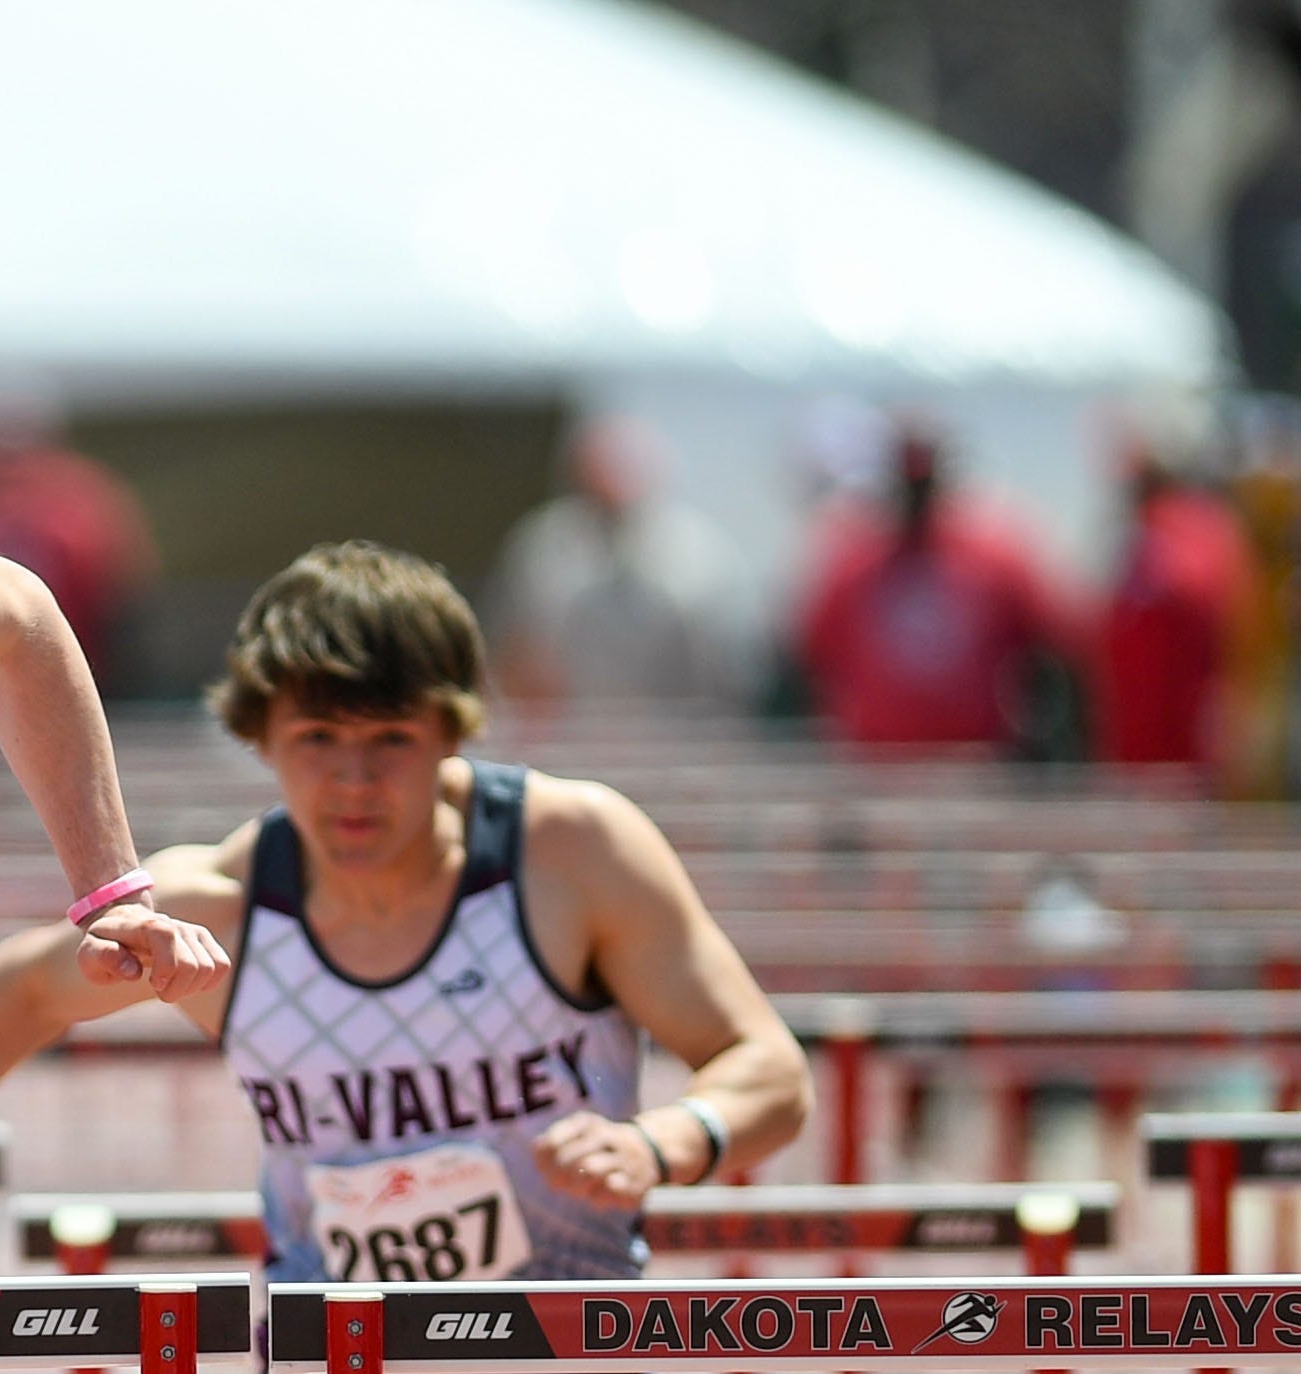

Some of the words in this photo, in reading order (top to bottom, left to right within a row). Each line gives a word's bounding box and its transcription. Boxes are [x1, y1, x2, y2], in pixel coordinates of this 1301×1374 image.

[328, 1194, 500, 1281] 2687
[12, 1308, 101, 1337] GILL
[425, 1313, 514, 1340] GILL
[582, 1296, 894, 1353] DAKOTA
[1024, 1293, 1301, 1349] RELAYS
